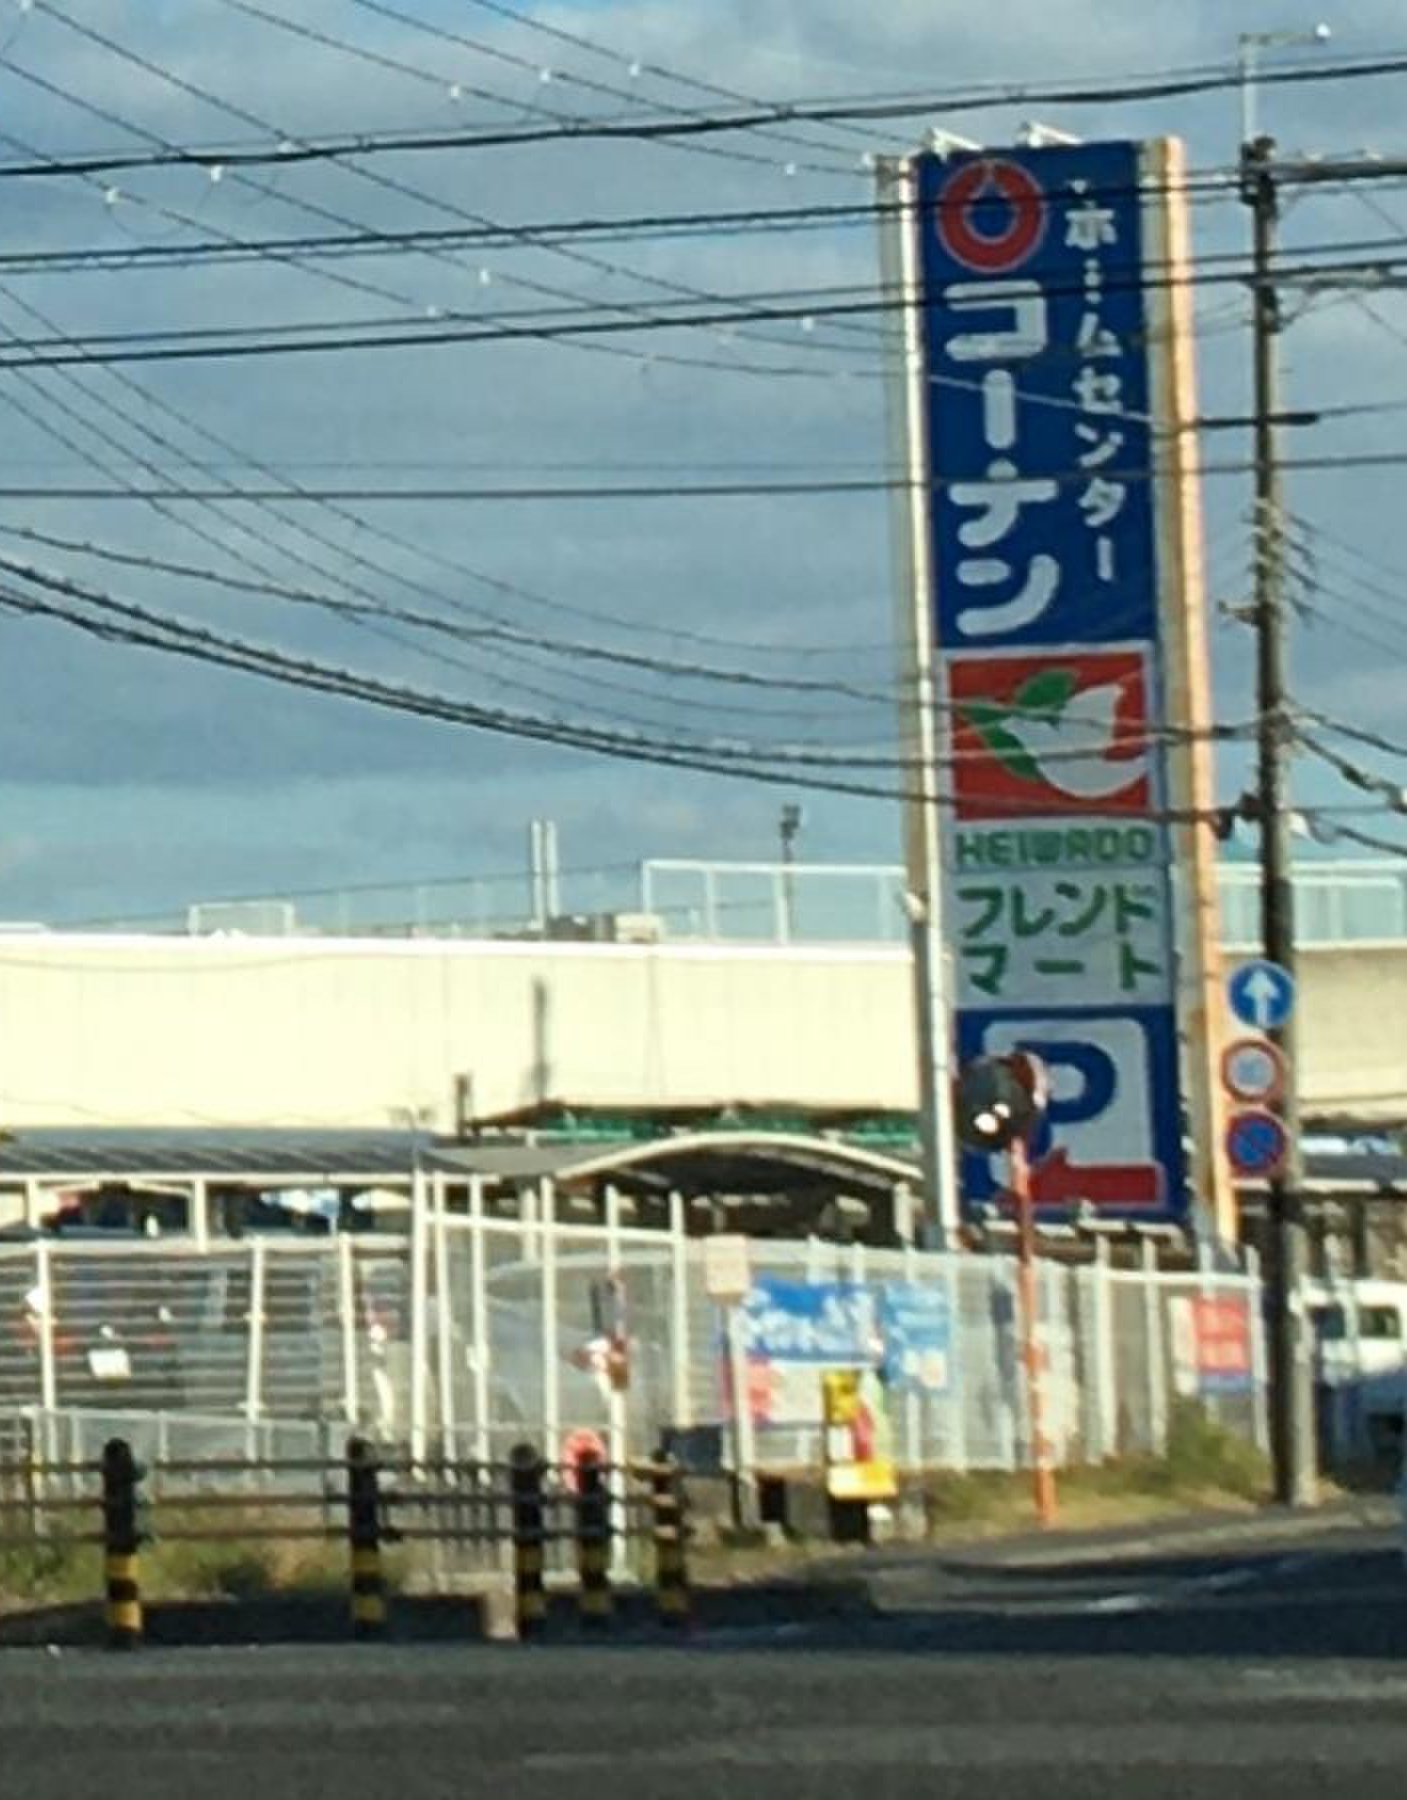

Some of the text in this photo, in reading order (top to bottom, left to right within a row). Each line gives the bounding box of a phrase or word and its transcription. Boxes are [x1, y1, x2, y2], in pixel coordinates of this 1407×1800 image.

[1064, 200, 1125, 582] ホームセンター
[943, 279, 1060, 637] コーナン
[955, 827, 1155, 866] HEIWADO
[956, 881, 1156, 939] フレンド
[961, 942, 1162, 996] マート
[1013, 1040, 1117, 1166] P
